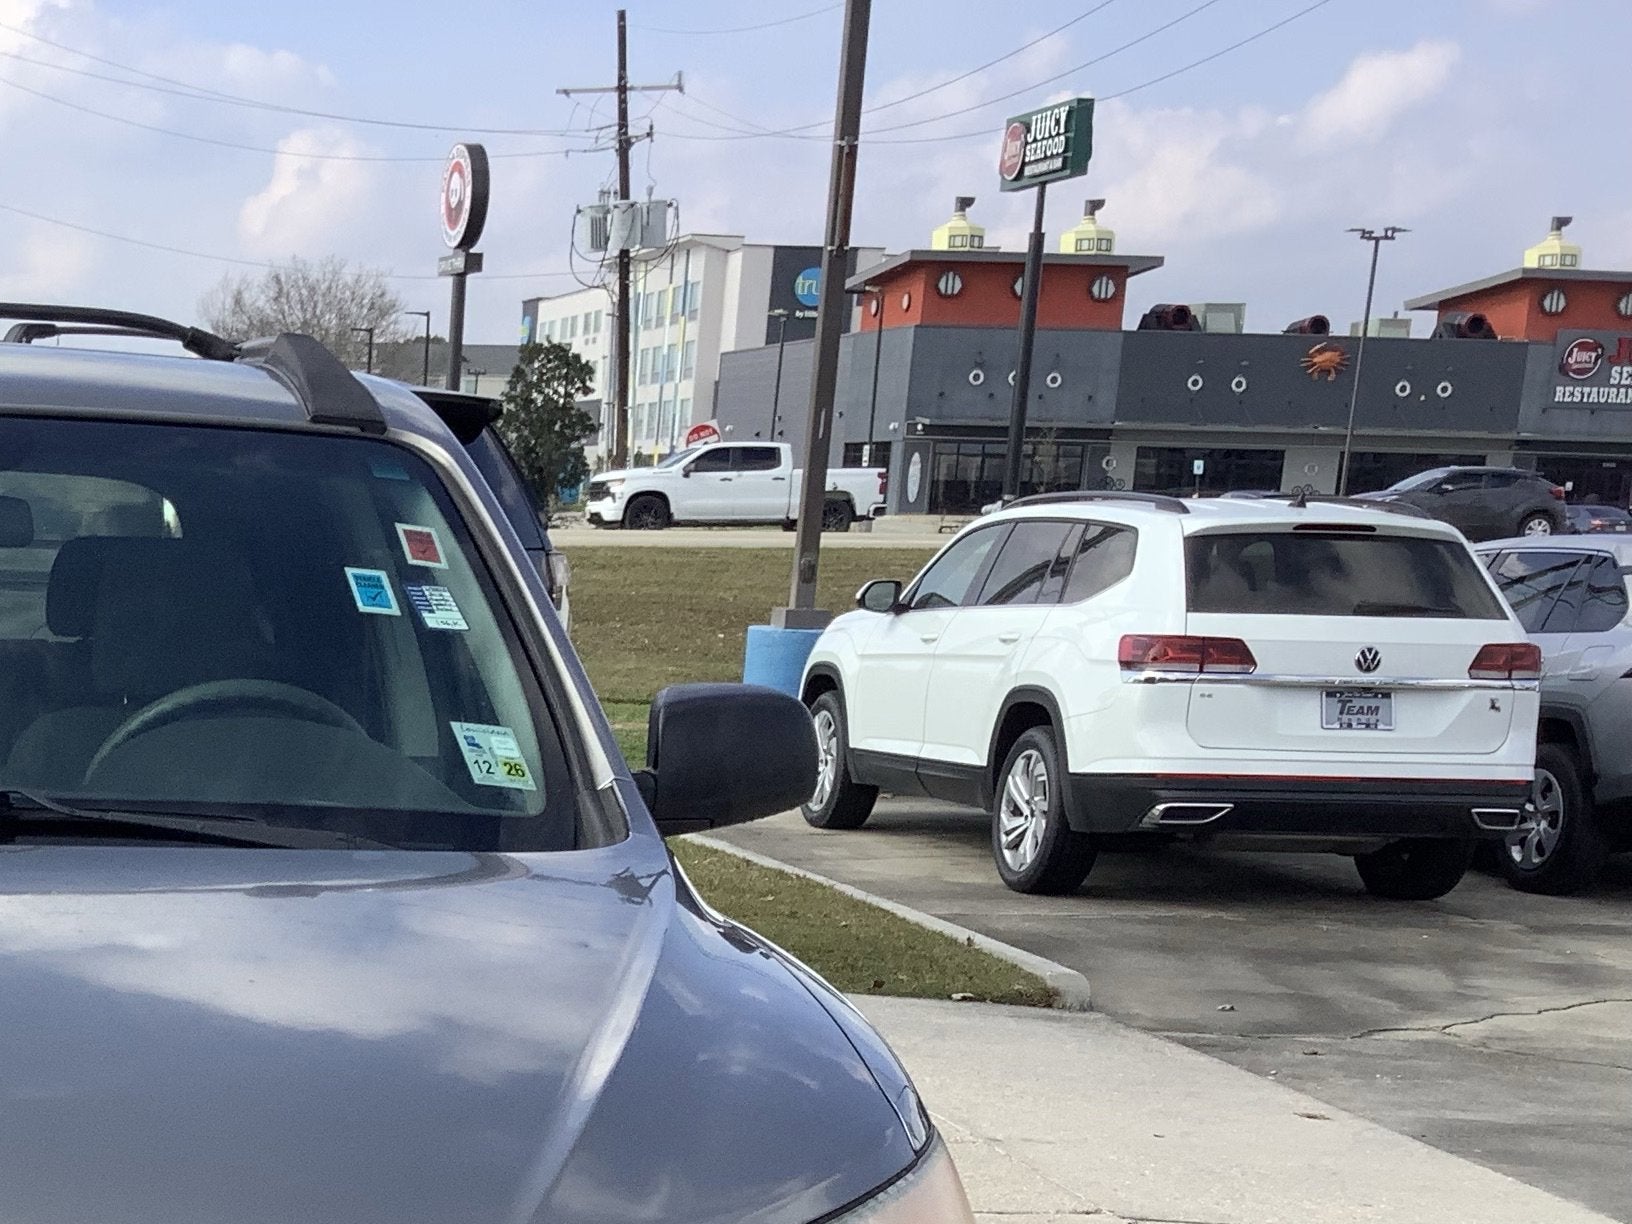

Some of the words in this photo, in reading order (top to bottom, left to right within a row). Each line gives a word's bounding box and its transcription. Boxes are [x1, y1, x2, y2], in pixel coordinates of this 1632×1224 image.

[1027, 105, 1069, 142] JUICY
[1025, 135, 1066, 162] SEAFOOD
[1609, 365, 1632, 385] SE
[1337, 699, 1380, 716] TEAM
[473, 759, 496, 775] 12
[503, 761, 525, 778] 26
